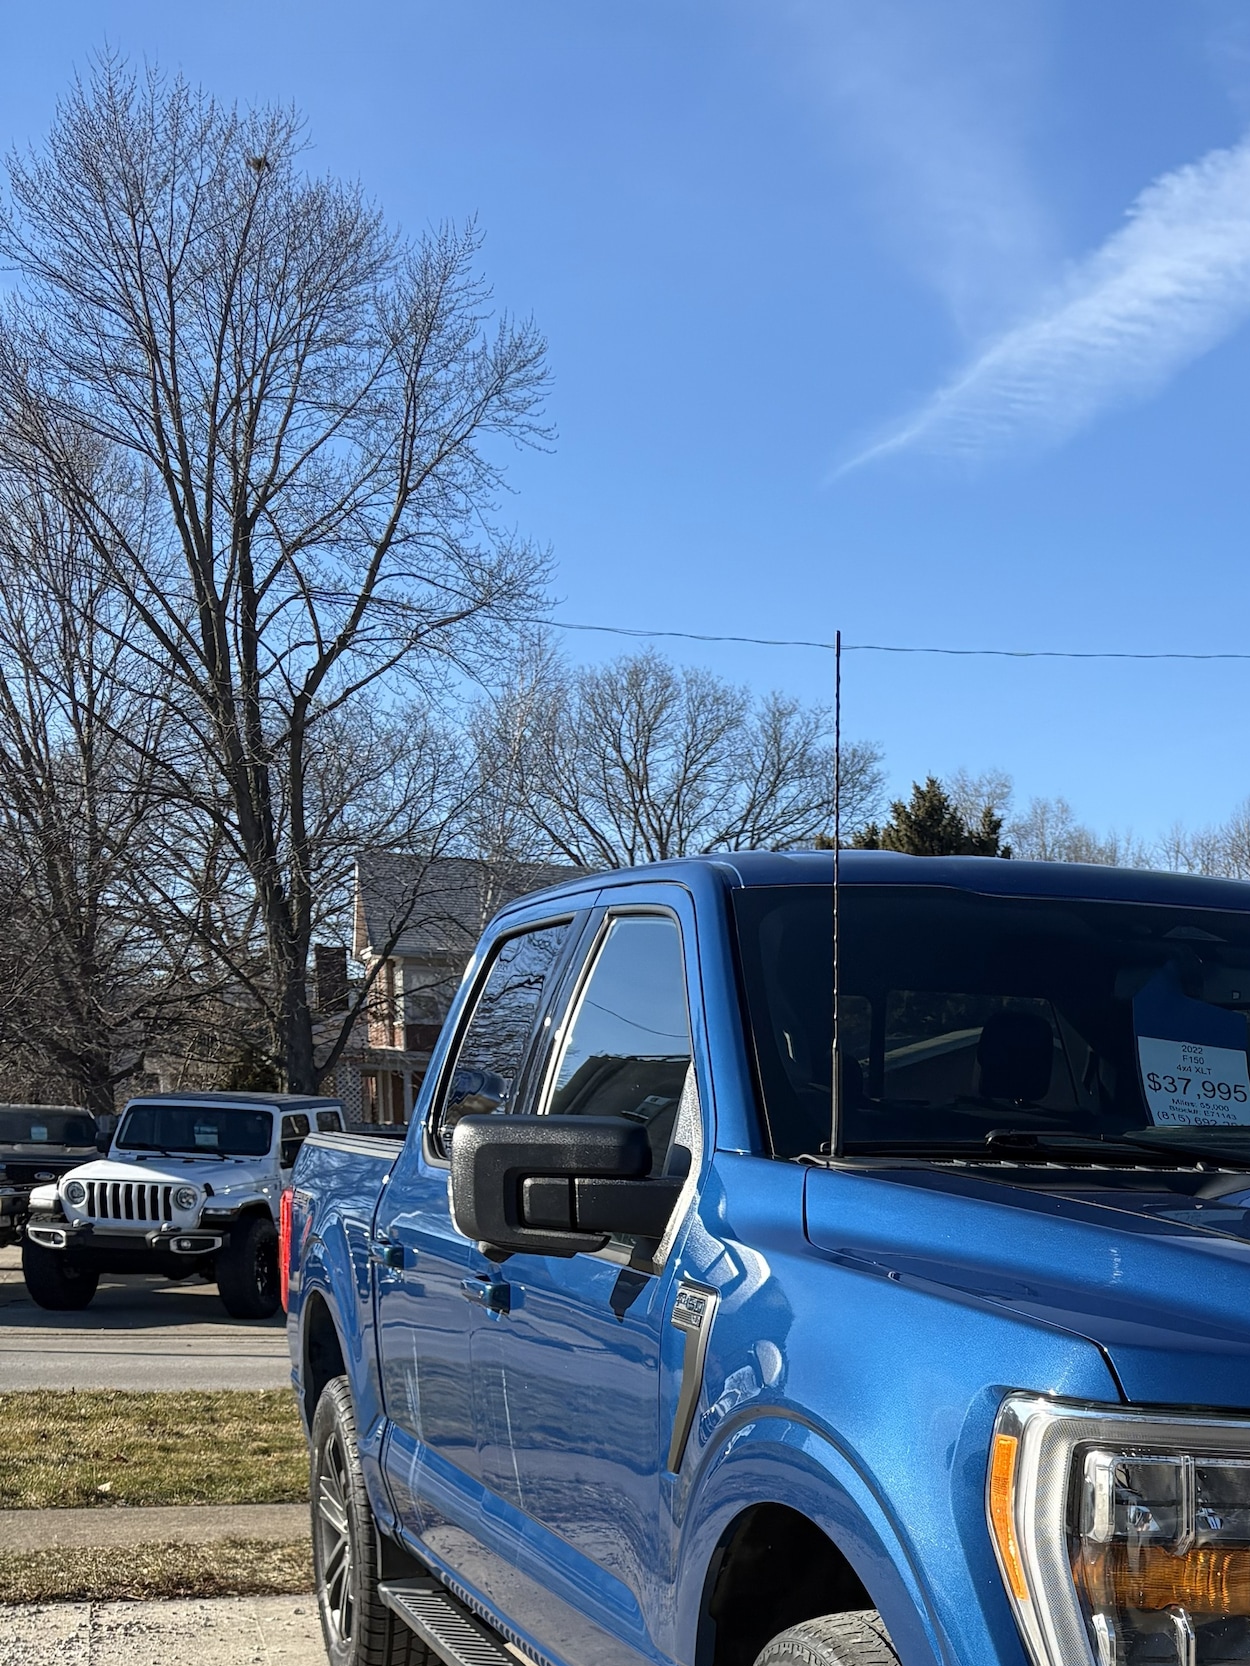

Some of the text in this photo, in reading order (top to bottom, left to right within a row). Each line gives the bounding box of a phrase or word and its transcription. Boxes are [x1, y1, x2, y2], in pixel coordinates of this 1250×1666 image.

[1181, 1044, 1203, 1055] 2022
[1176, 1064, 1212, 1075] 4x4 XLT
[1146, 1072, 1248, 1103] $37,995
[1157, 1111, 1191, 1125] (815)
